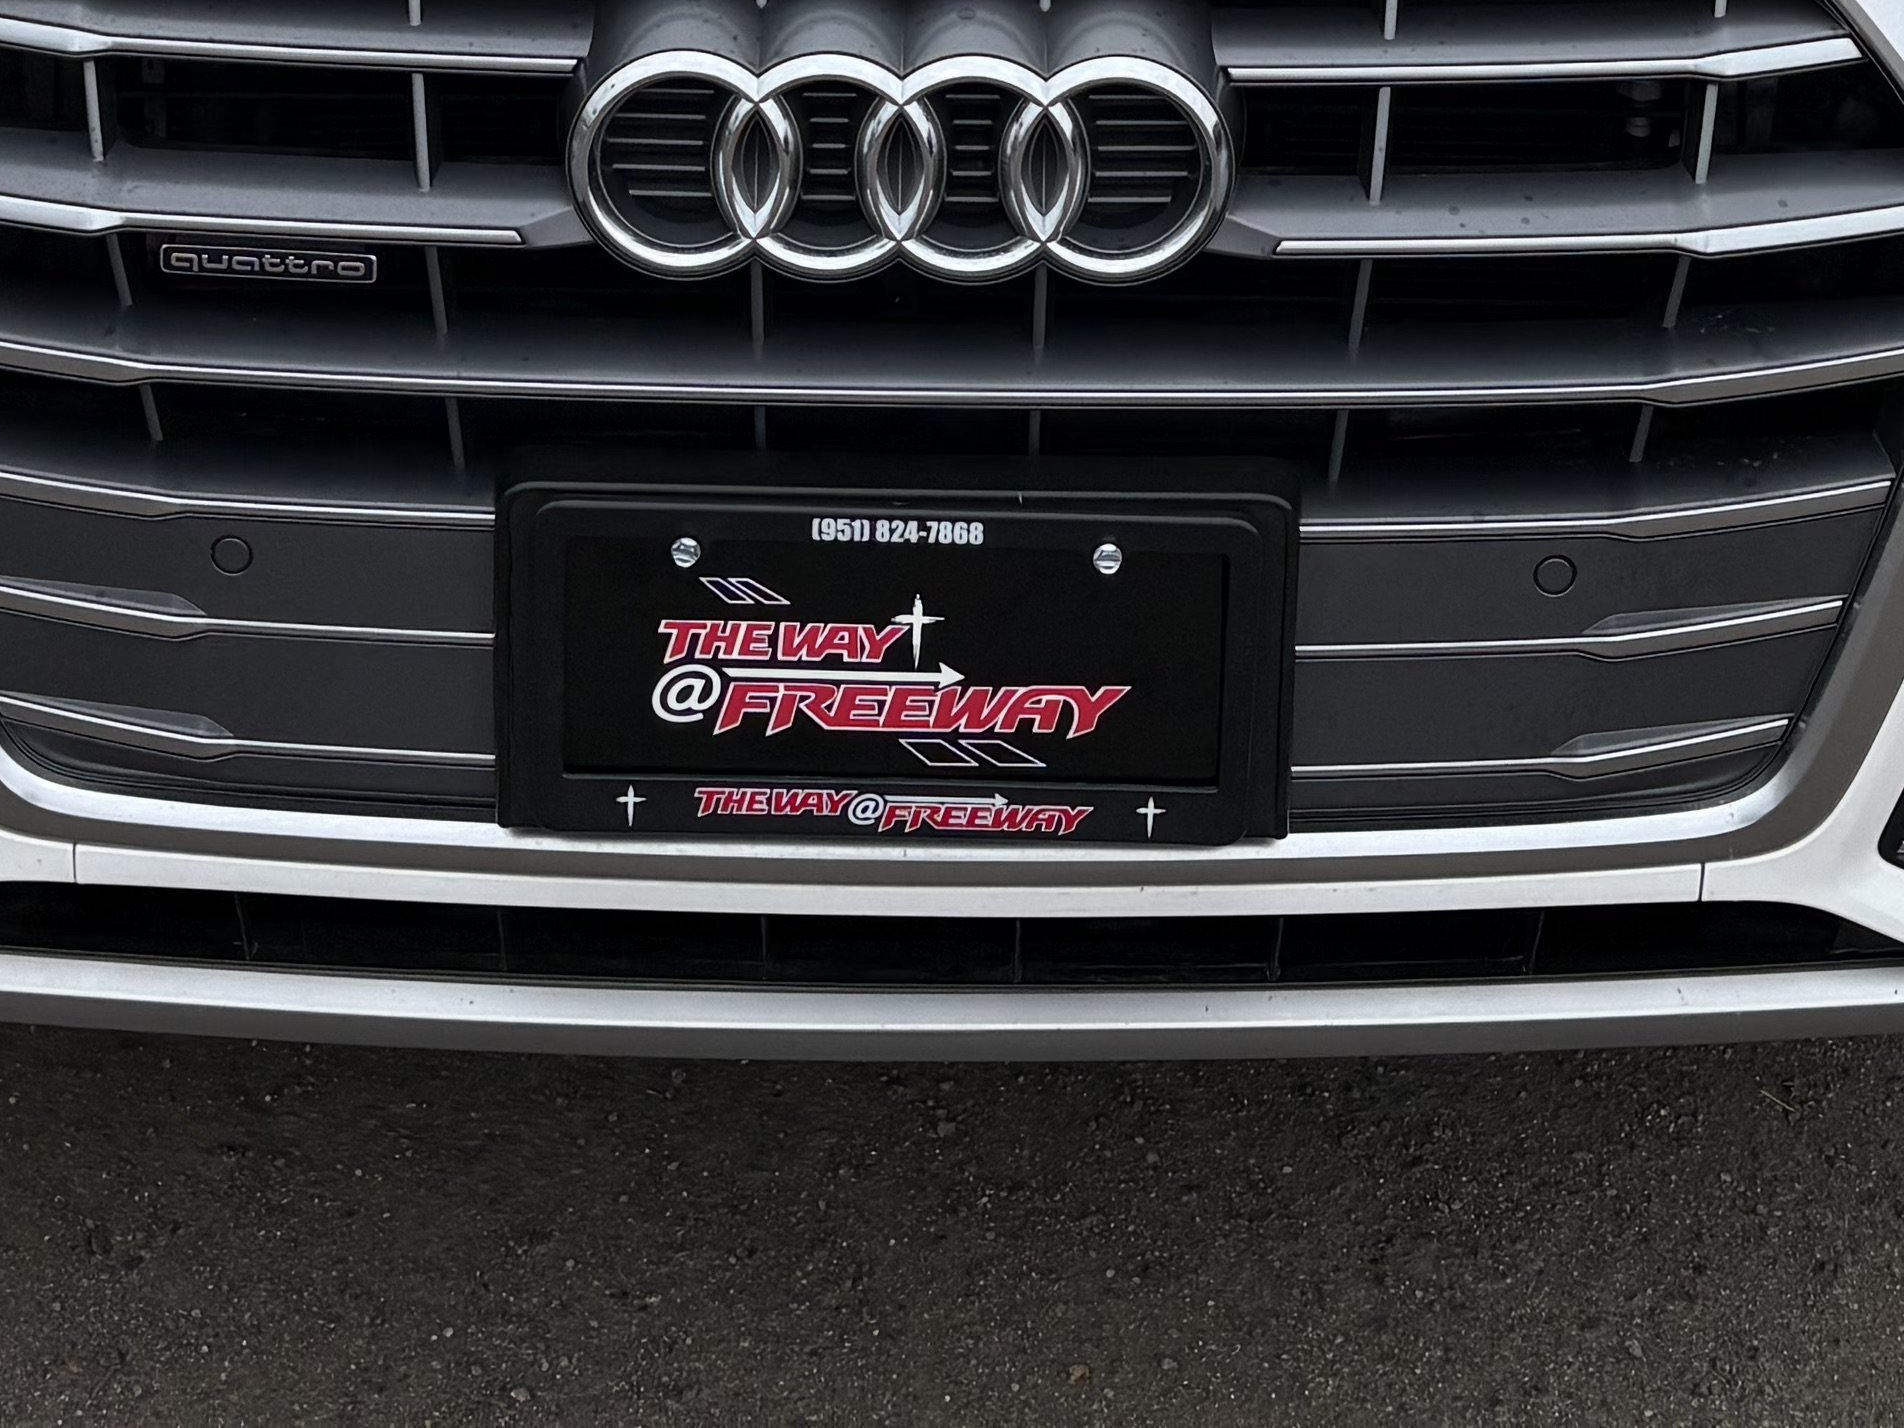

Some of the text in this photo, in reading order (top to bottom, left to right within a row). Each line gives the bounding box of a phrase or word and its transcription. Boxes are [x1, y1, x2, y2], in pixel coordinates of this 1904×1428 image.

[170, 251, 366, 278] quattro
[811, 517, 985, 545] (951) 824-7868
[658, 619, 911, 665] THE WAY
